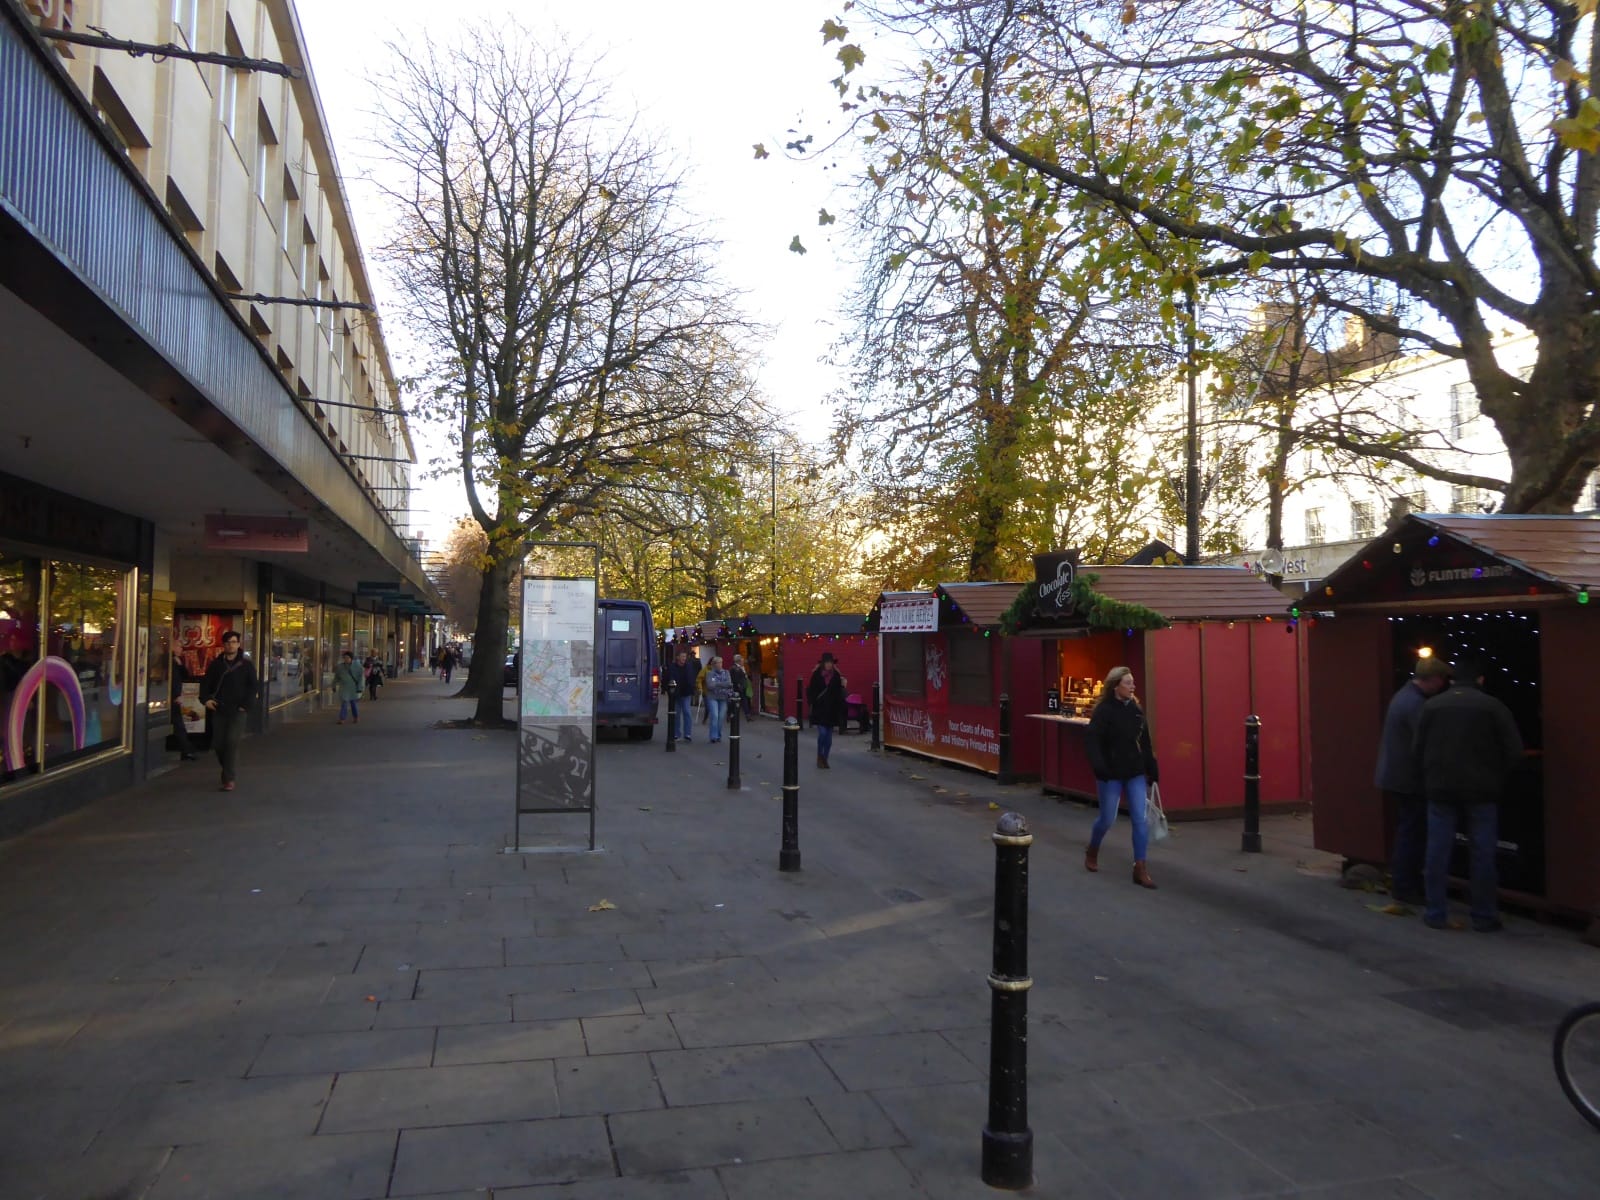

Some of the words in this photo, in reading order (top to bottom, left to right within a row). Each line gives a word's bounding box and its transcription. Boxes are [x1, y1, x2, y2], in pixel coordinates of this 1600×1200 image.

[1254, 557, 1306, 574] Nest
[1039, 560, 1073, 598] Chocolate
[974, 723, 980, 736] of
[980, 725, 995, 739] Arms
[988, 741, 1000, 755] HER
[569, 755, 588, 780] 27
